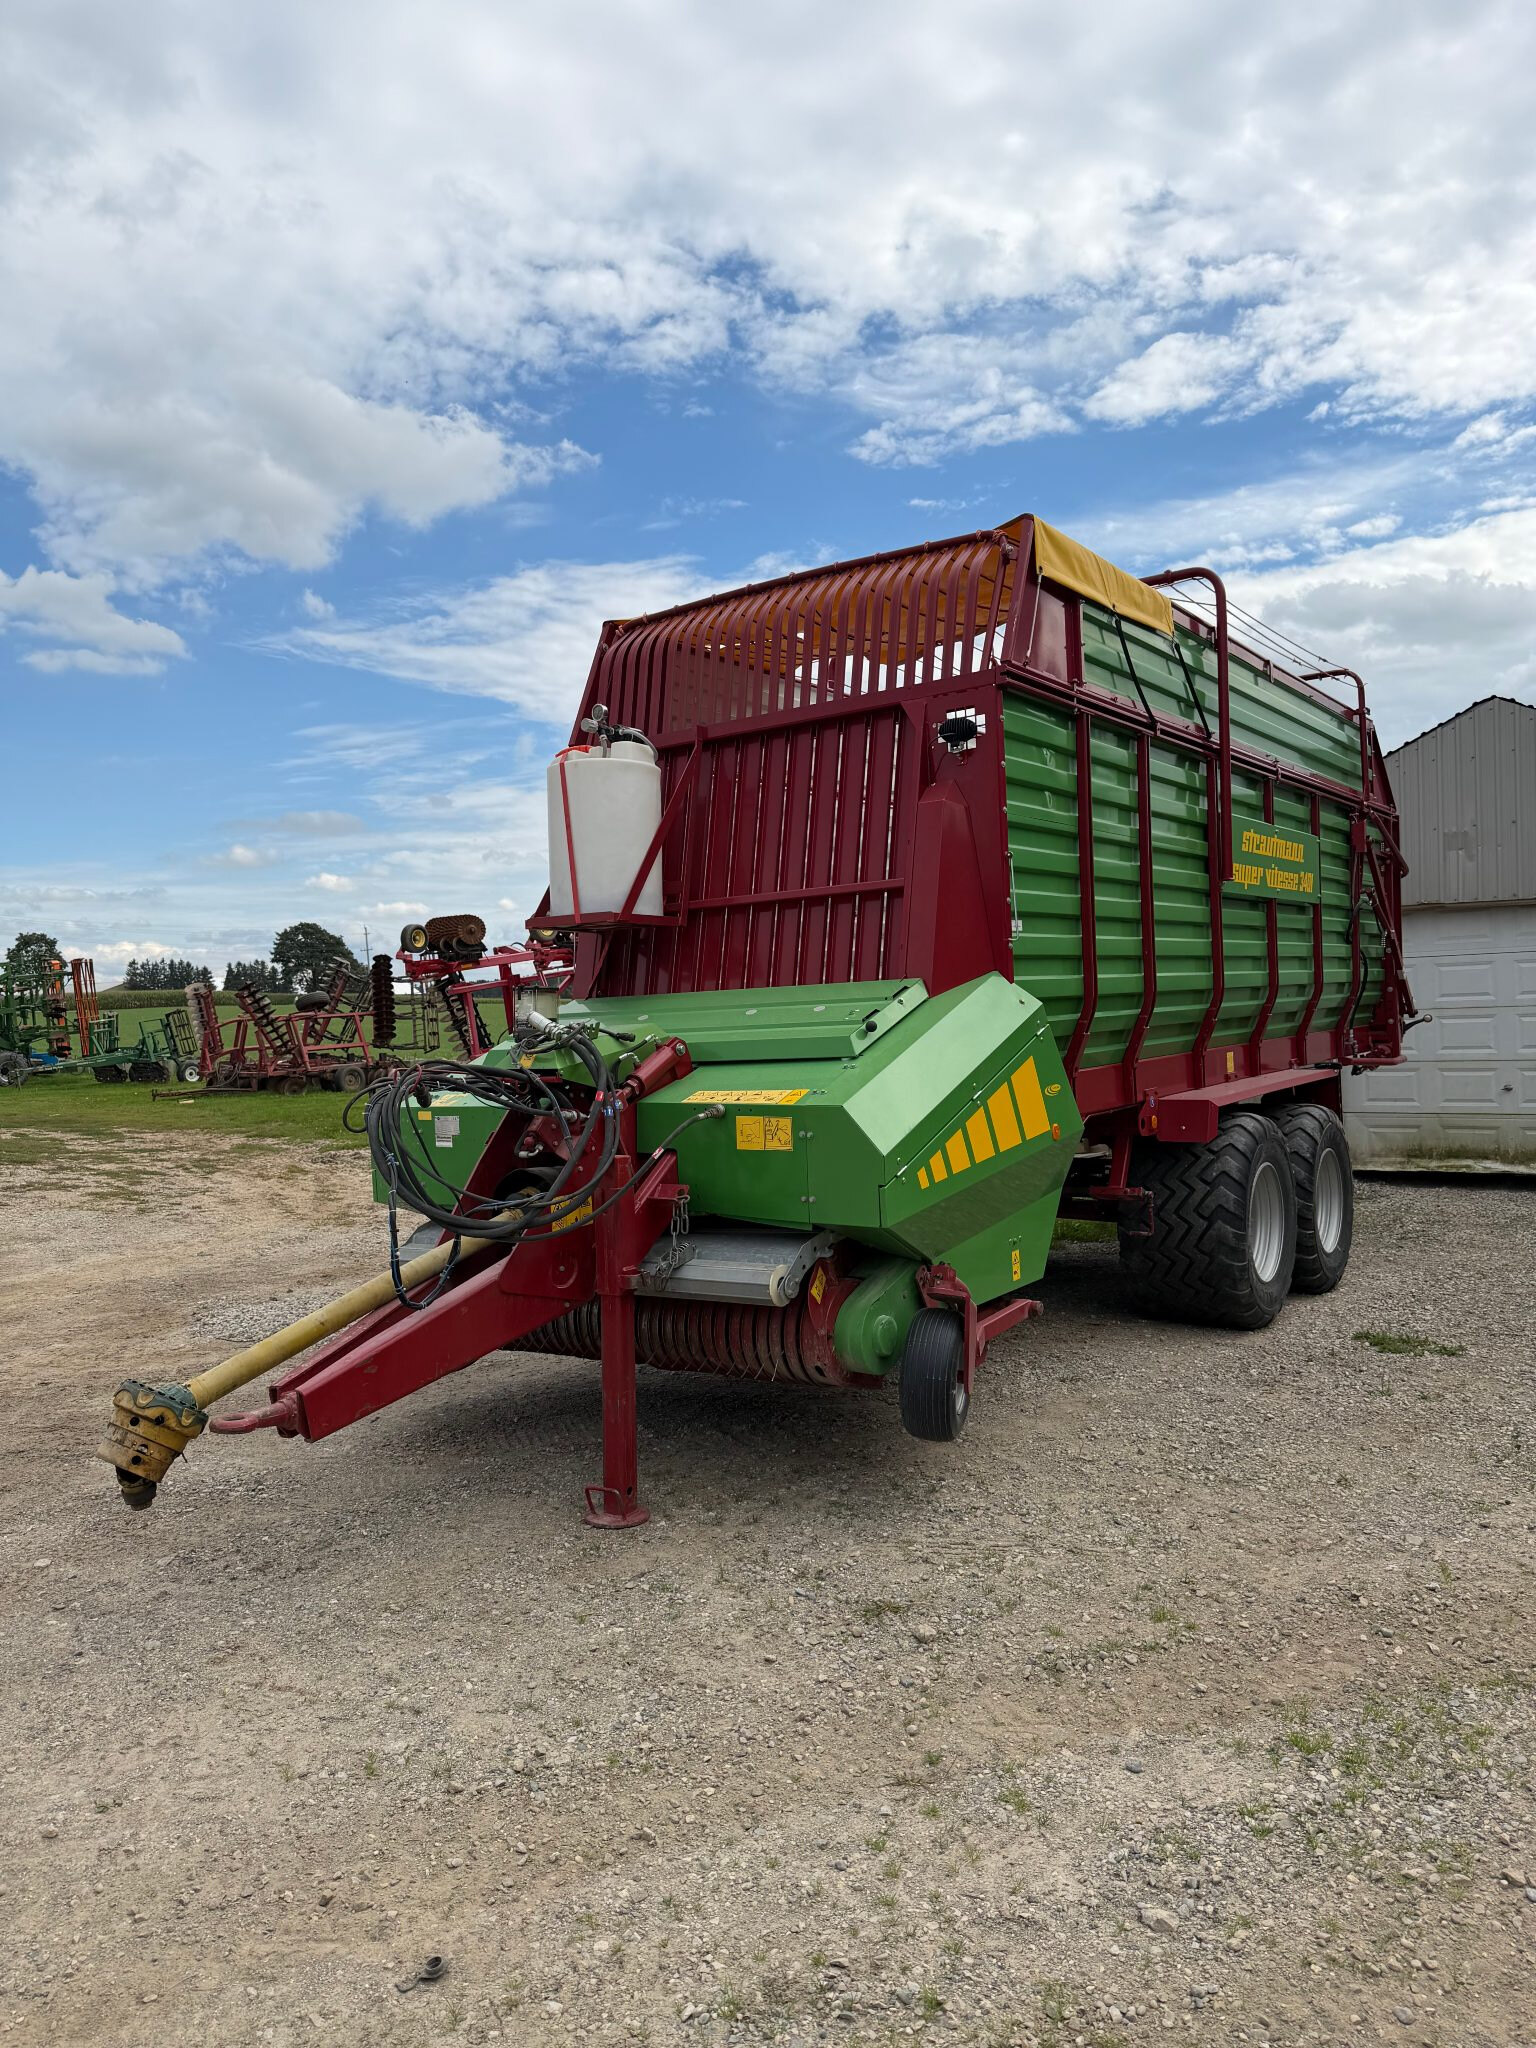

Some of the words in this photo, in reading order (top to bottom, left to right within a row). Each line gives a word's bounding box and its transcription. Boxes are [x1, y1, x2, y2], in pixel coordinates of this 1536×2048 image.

[1242, 829, 1304, 862] strautmann
[1233, 863, 1263, 889] super
[1265, 863, 1299, 891] vitesse
